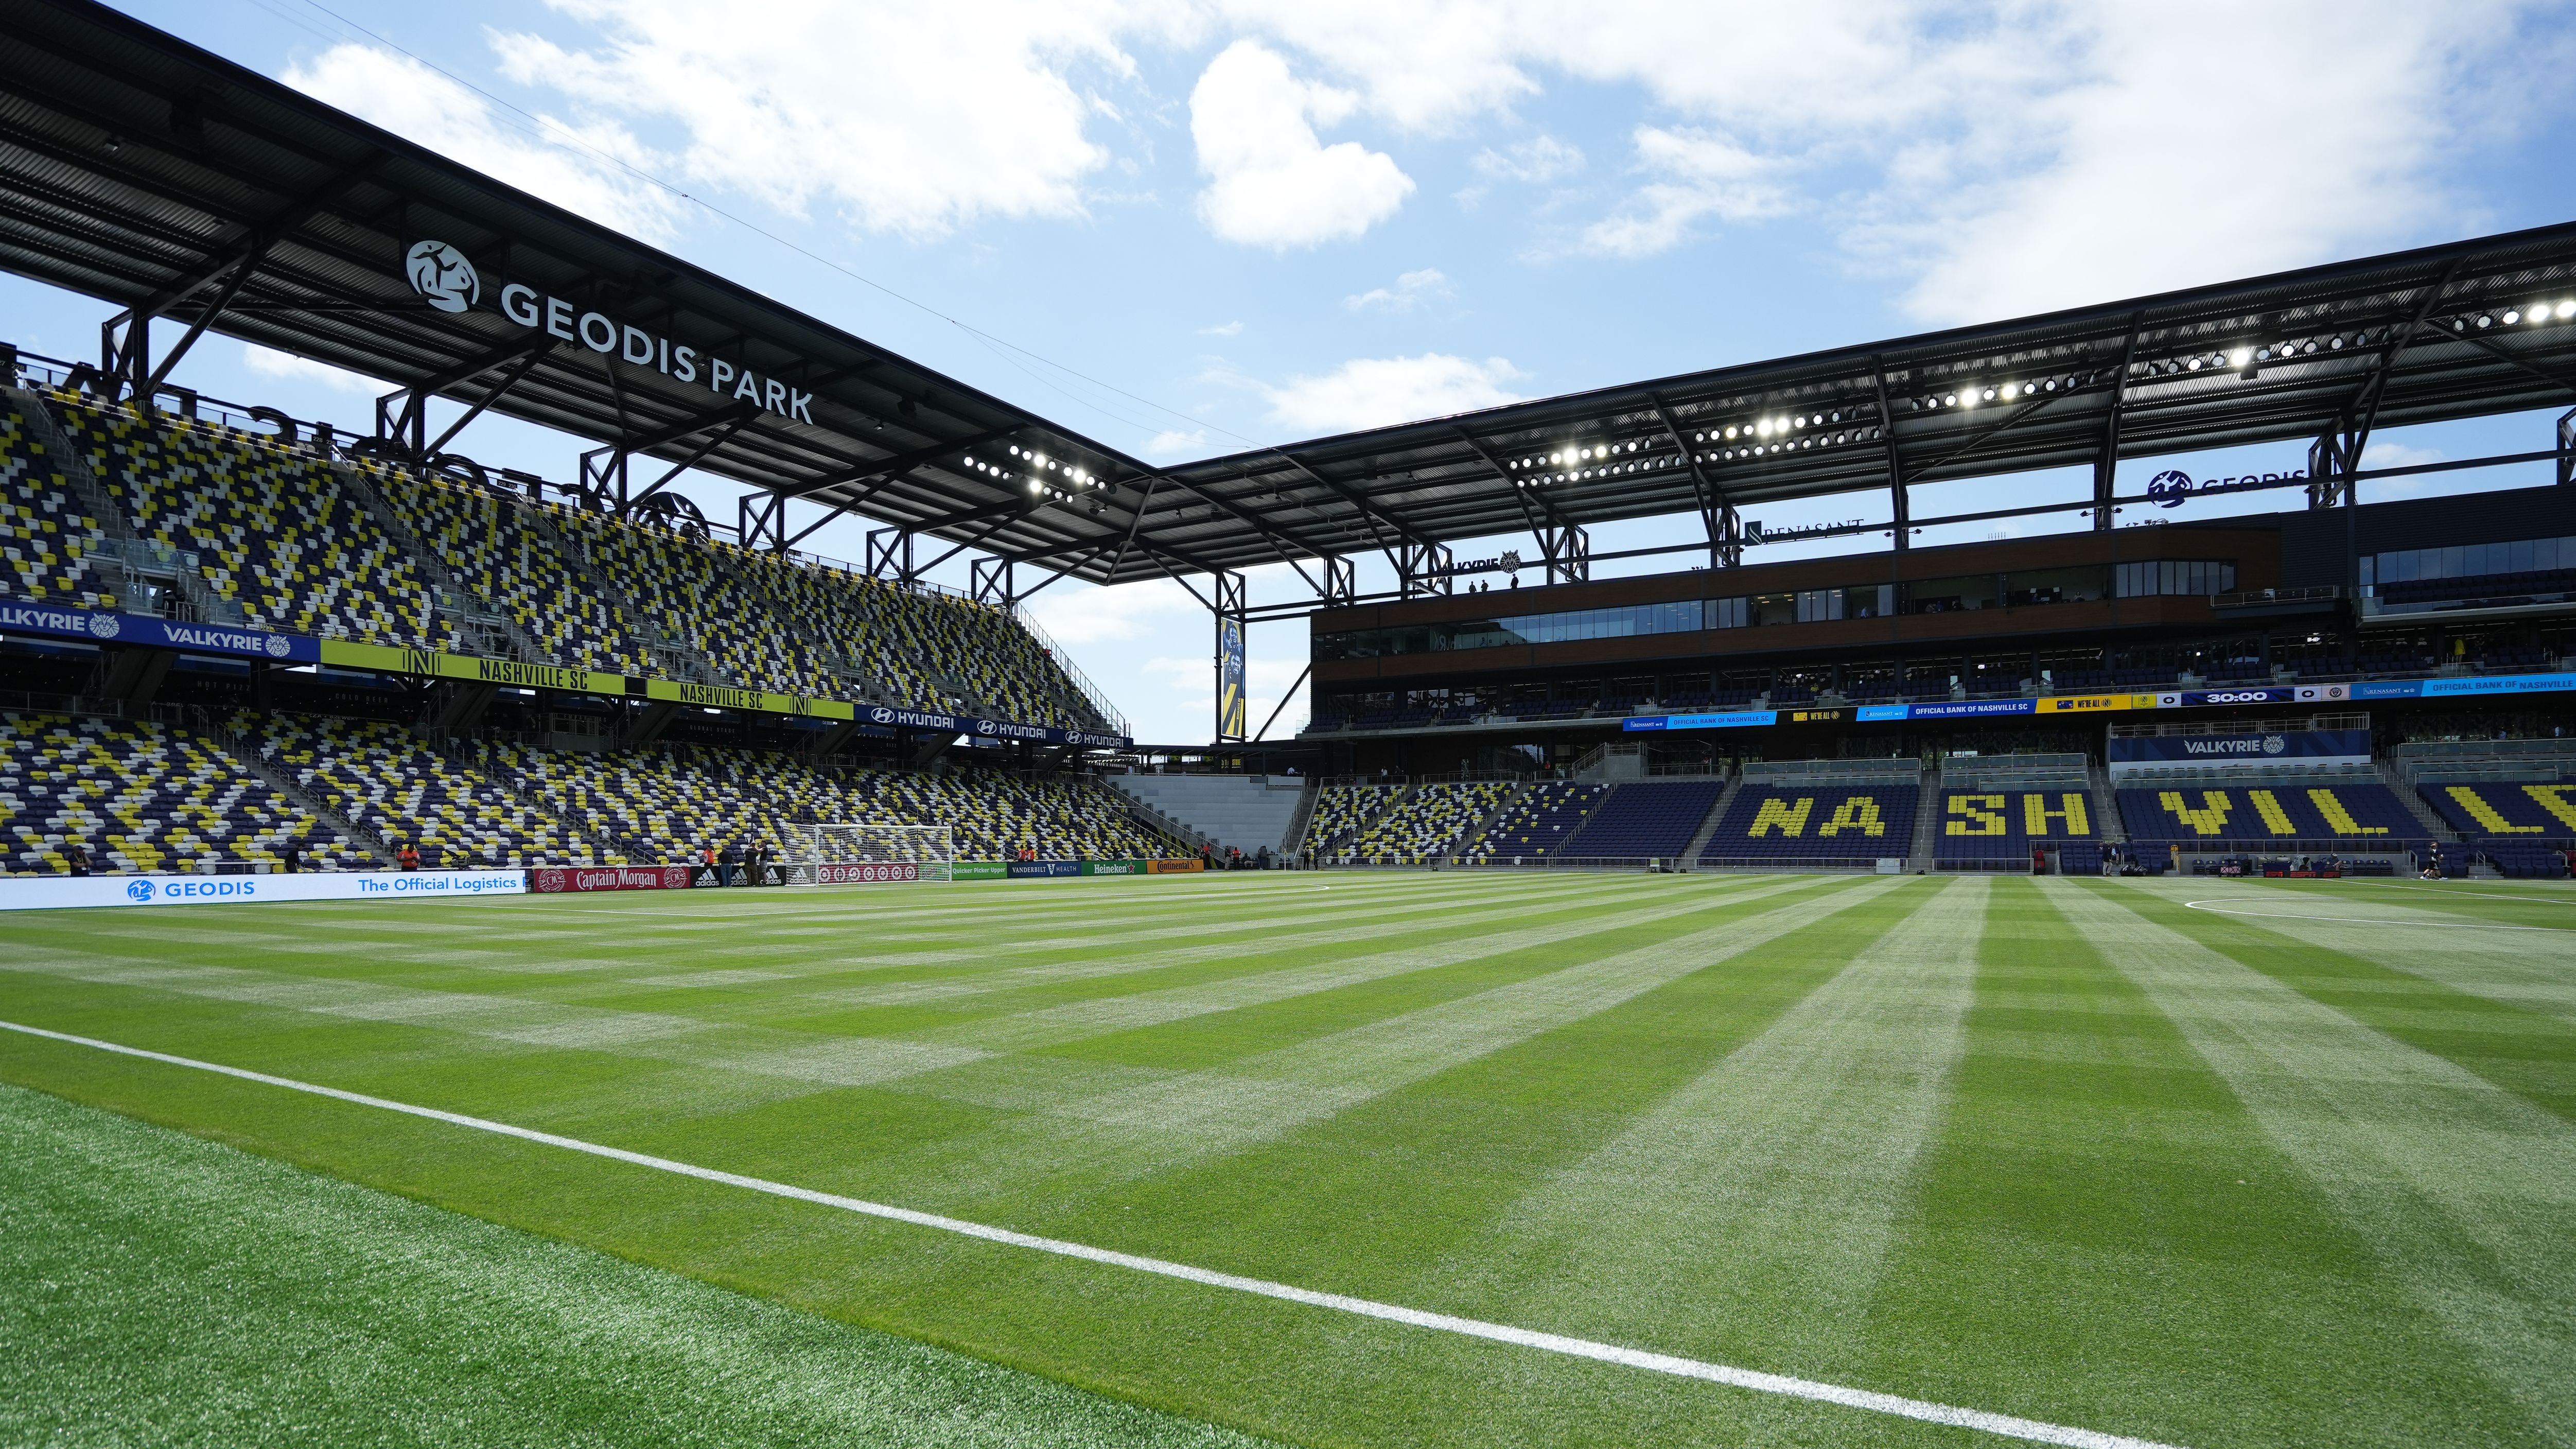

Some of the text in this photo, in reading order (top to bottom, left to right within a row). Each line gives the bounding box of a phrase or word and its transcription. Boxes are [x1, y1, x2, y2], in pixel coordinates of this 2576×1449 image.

[501, 283, 814, 426] GEODIS PARK
[2201, 469, 2305, 496] GEODIS
[1764, 519, 1864, 542] RENASANT
[0, 607, 85, 631] LKYRIE
[163, 623, 262, 651] VALKYRIE
[479, 659, 588, 690] NASHVILLE SC
[197, 680, 217, 689] HOT
[2433, 683, 2473, 691] OFFICIAL
[2475, 681, 2502, 689] BANK
[2519, 680, 2573, 689] NASHVILLE
[335, 693, 359, 701] COLD
[680, 684, 762, 709] NASHVILLE SC
[2207, 692, 2267, 703] 30:00
[2301, 690, 2315, 698] 0
[2077, 700, 2092, 708] WE'RE
[898, 711, 954, 729] HYUNDAI
[1000, 723, 1046, 739] HYUNDAI
[1084, 734, 1124, 748] HYUNDAI
[2184, 740, 2260, 753] VALKYRIE
[1094, 863, 1127, 874] Heineken
[1157, 861, 1190, 872] Continental
[358, 879, 389, 892] The
[394, 877, 449, 891] Official
[454, 877, 516, 892] Logistics
[576, 869, 657, 891] Captain Morgan
[695, 878, 720, 886] adidas
[165, 881, 255, 897] GEODIS
